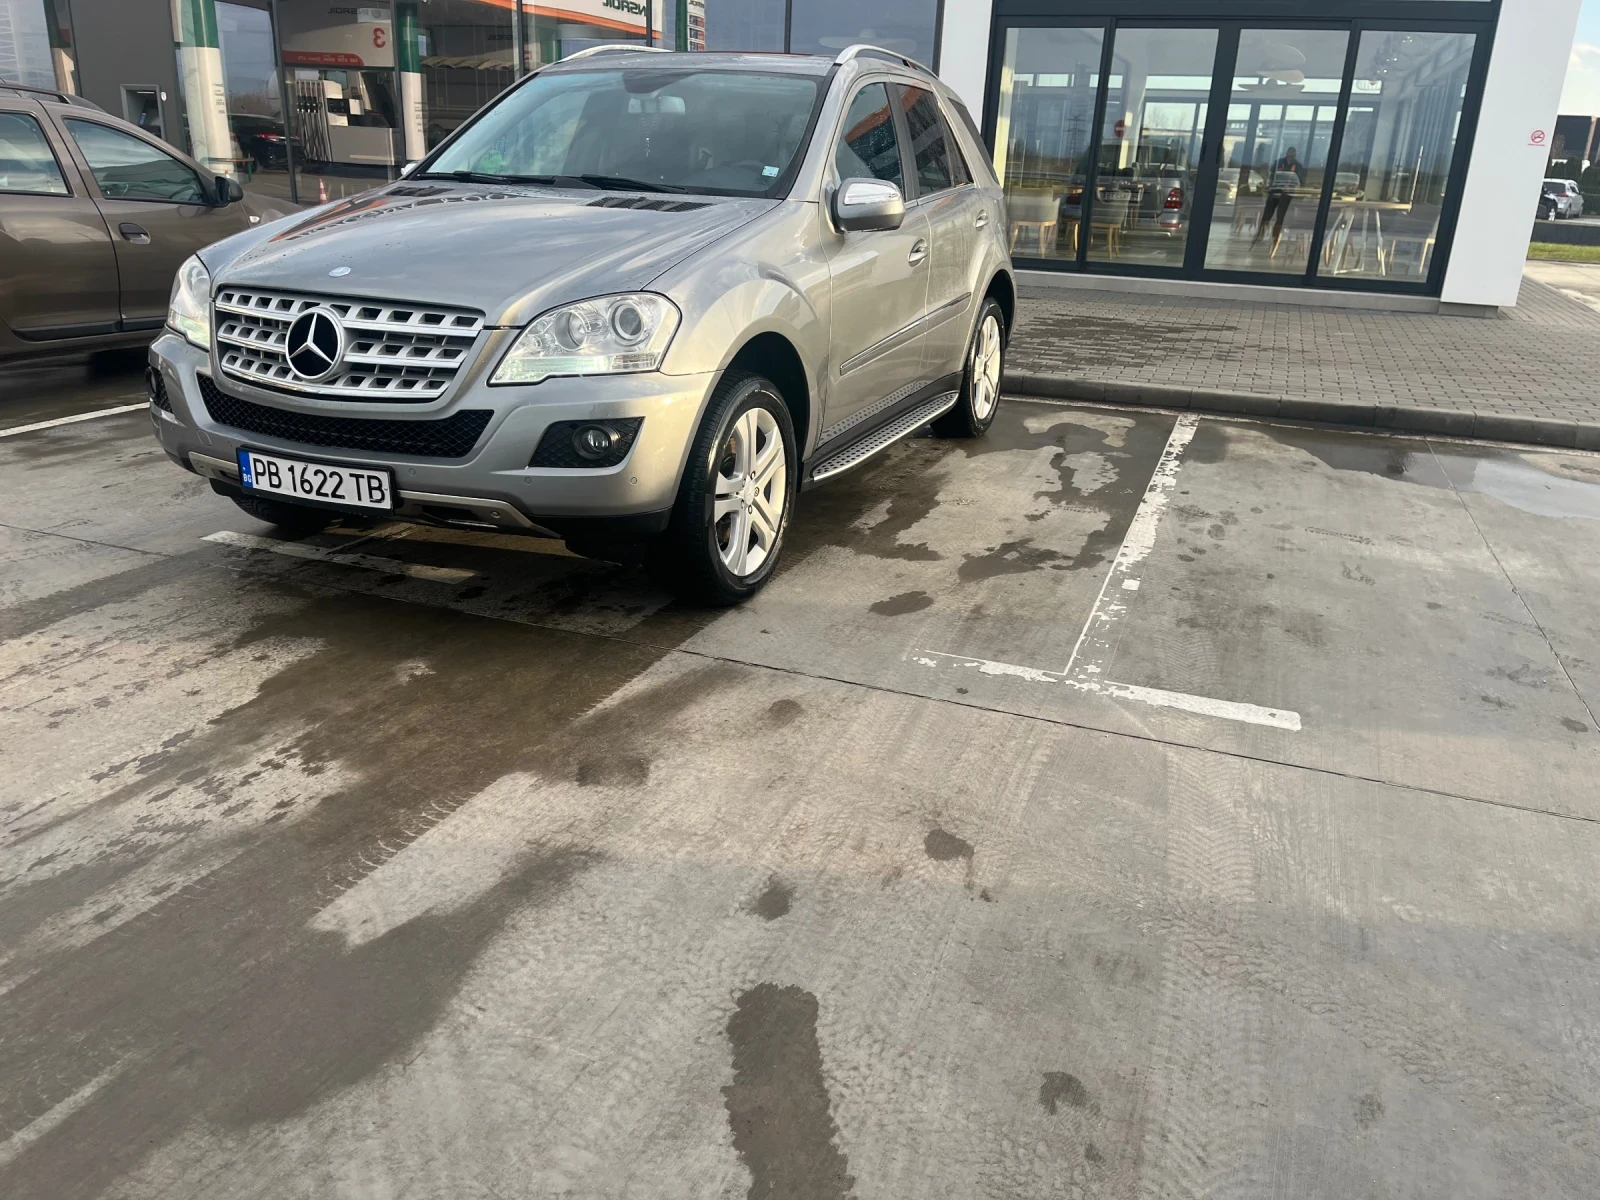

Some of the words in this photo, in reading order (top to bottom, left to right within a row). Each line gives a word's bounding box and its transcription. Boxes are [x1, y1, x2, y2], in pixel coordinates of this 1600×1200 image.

[243, 473, 252, 483] BG
[253, 457, 282, 489] PB
[288, 464, 345, 499] 1622
[350, 473, 386, 503] TB
